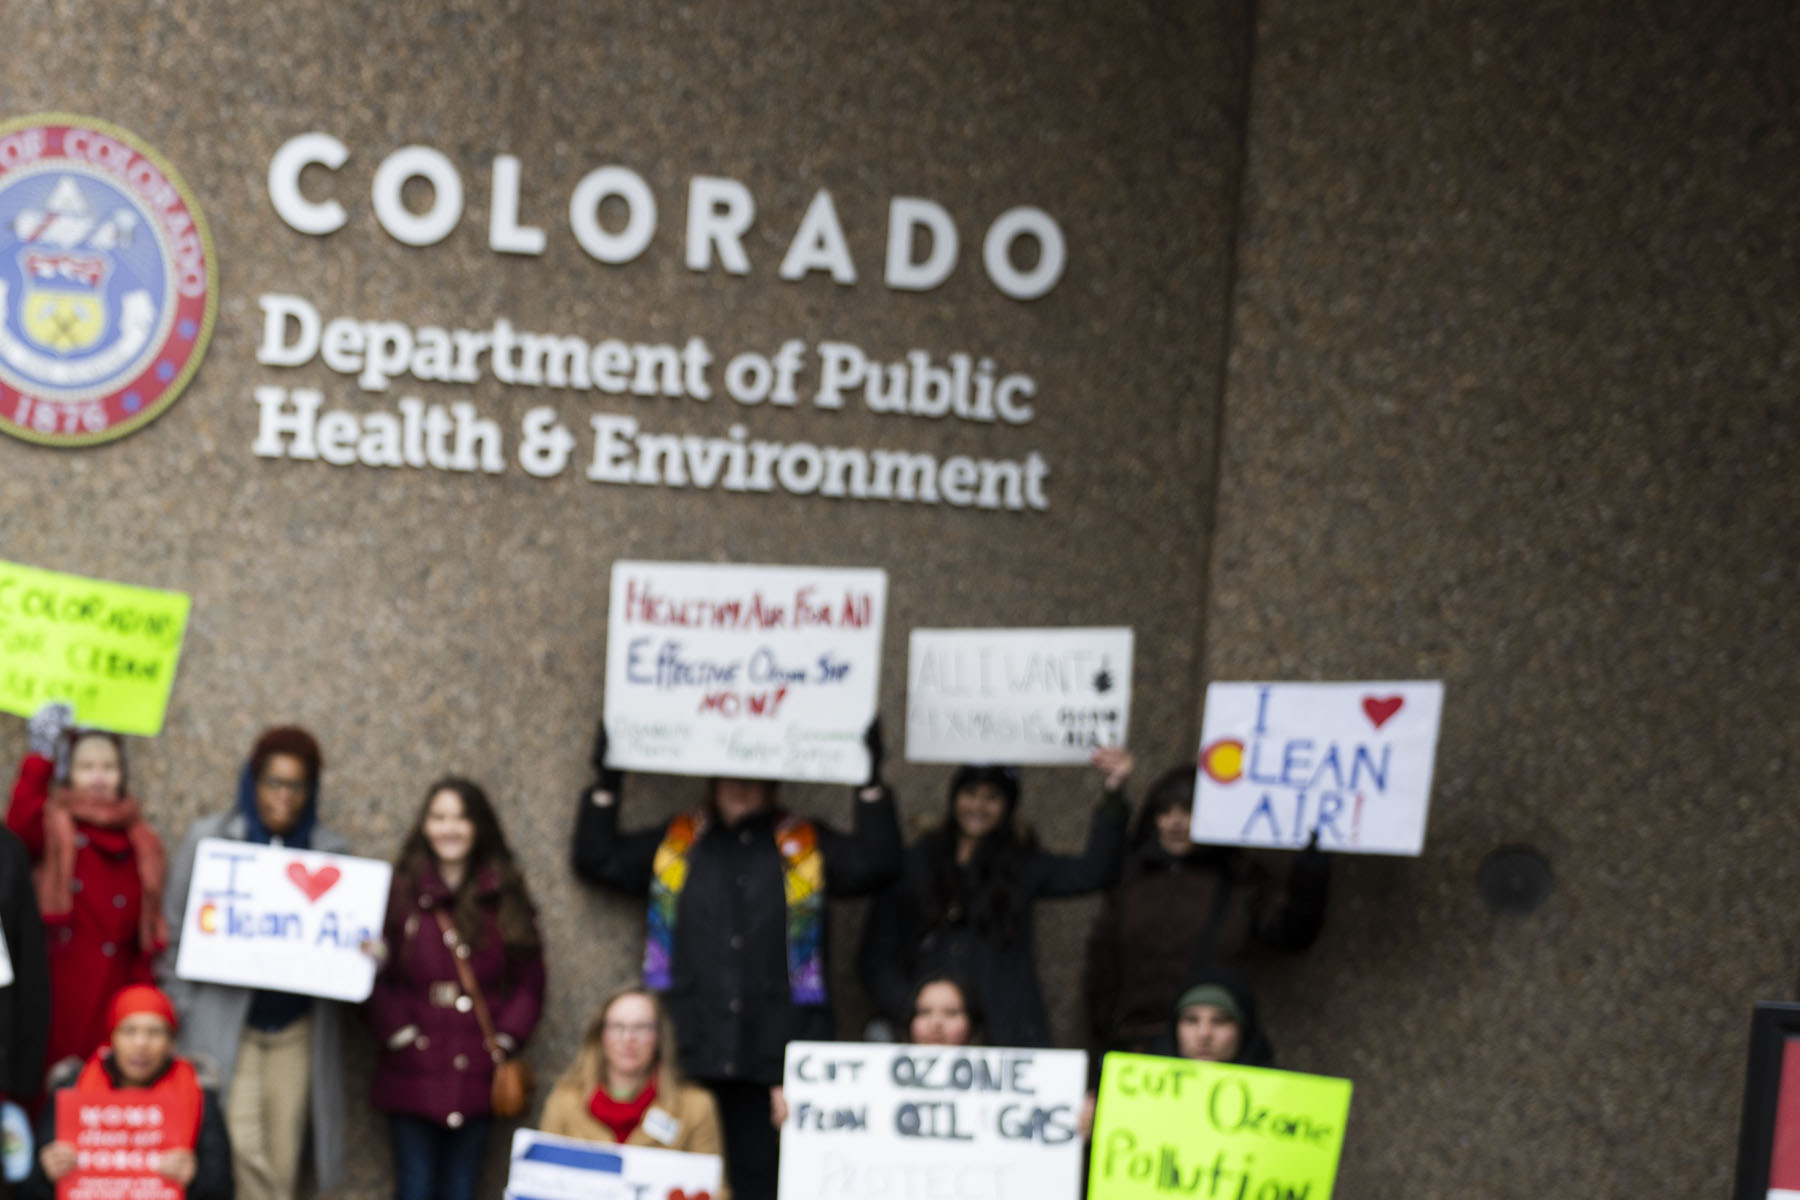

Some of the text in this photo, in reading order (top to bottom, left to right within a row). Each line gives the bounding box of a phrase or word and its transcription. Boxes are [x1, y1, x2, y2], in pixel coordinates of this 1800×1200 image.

[62, 129, 207, 300] COLORADO
[266, 130, 1068, 300] COLORADO
[256, 293, 1036, 423] Department of Public
[14, 396, 108, 434] 1876
[253, 388, 1050, 510] Health & Environment
[1255, 684, 1273, 732] I
[1200, 739, 1393, 794] CLEAN
[1240, 789, 1366, 846] AIR!
[204, 851, 257, 899] I
[198, 904, 303, 938] Clean
[890, 1055, 1036, 1096] OZONE
